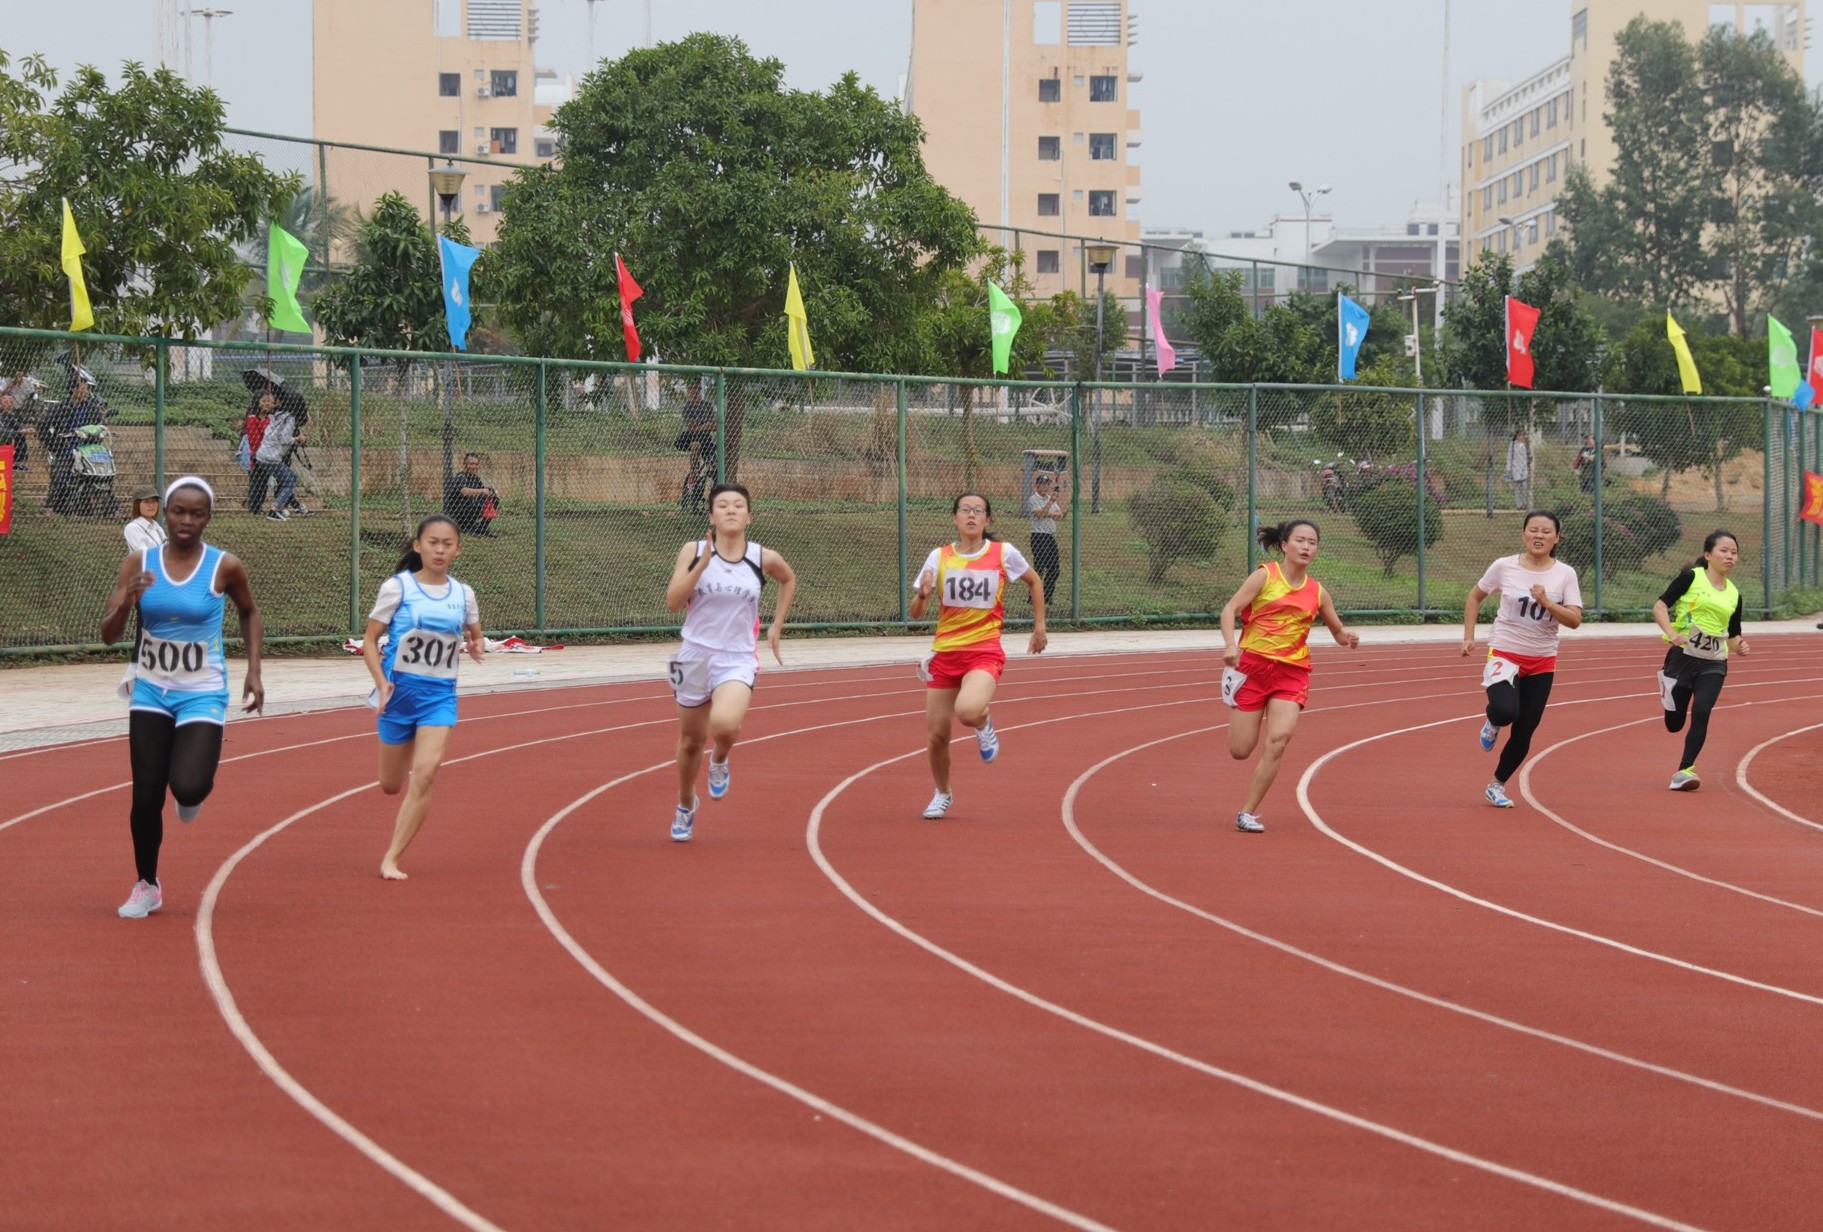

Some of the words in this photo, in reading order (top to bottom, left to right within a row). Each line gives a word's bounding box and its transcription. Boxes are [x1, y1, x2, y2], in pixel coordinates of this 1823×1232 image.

[946, 576, 991, 602] 184
[402, 636, 457, 669] 301
[1689, 631, 1719, 652] 420
[141, 638, 203, 672] 500
[670, 661, 684, 685] 5
[1490, 661, 1503, 677] 2
